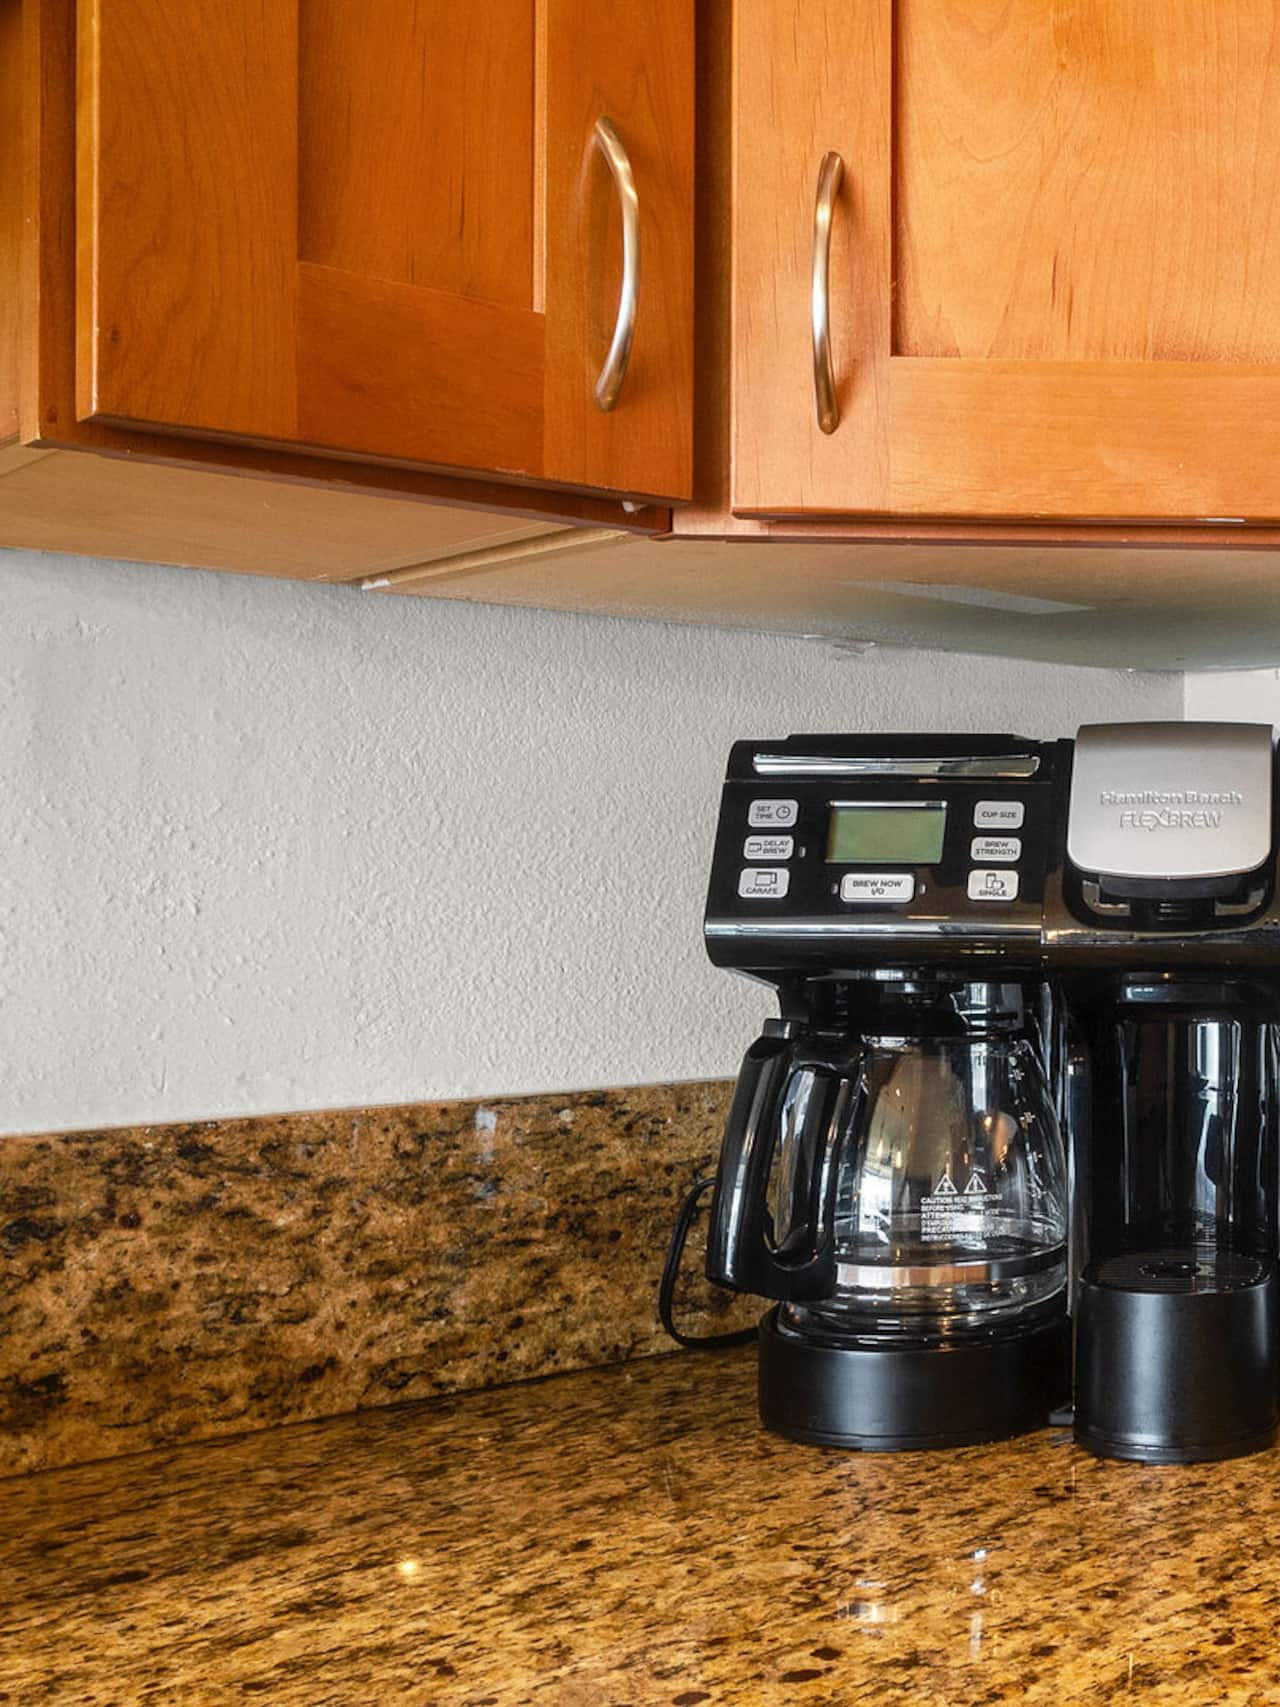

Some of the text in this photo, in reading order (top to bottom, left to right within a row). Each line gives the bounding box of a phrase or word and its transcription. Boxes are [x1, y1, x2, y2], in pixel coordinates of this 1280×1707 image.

[1100, 791, 1243, 805] Hamilton Beach
[1119, 807, 1223, 832] FLEXBREW
[976, 848, 1017, 856] STRENGTH
[745, 887, 779, 895] CARAFE
